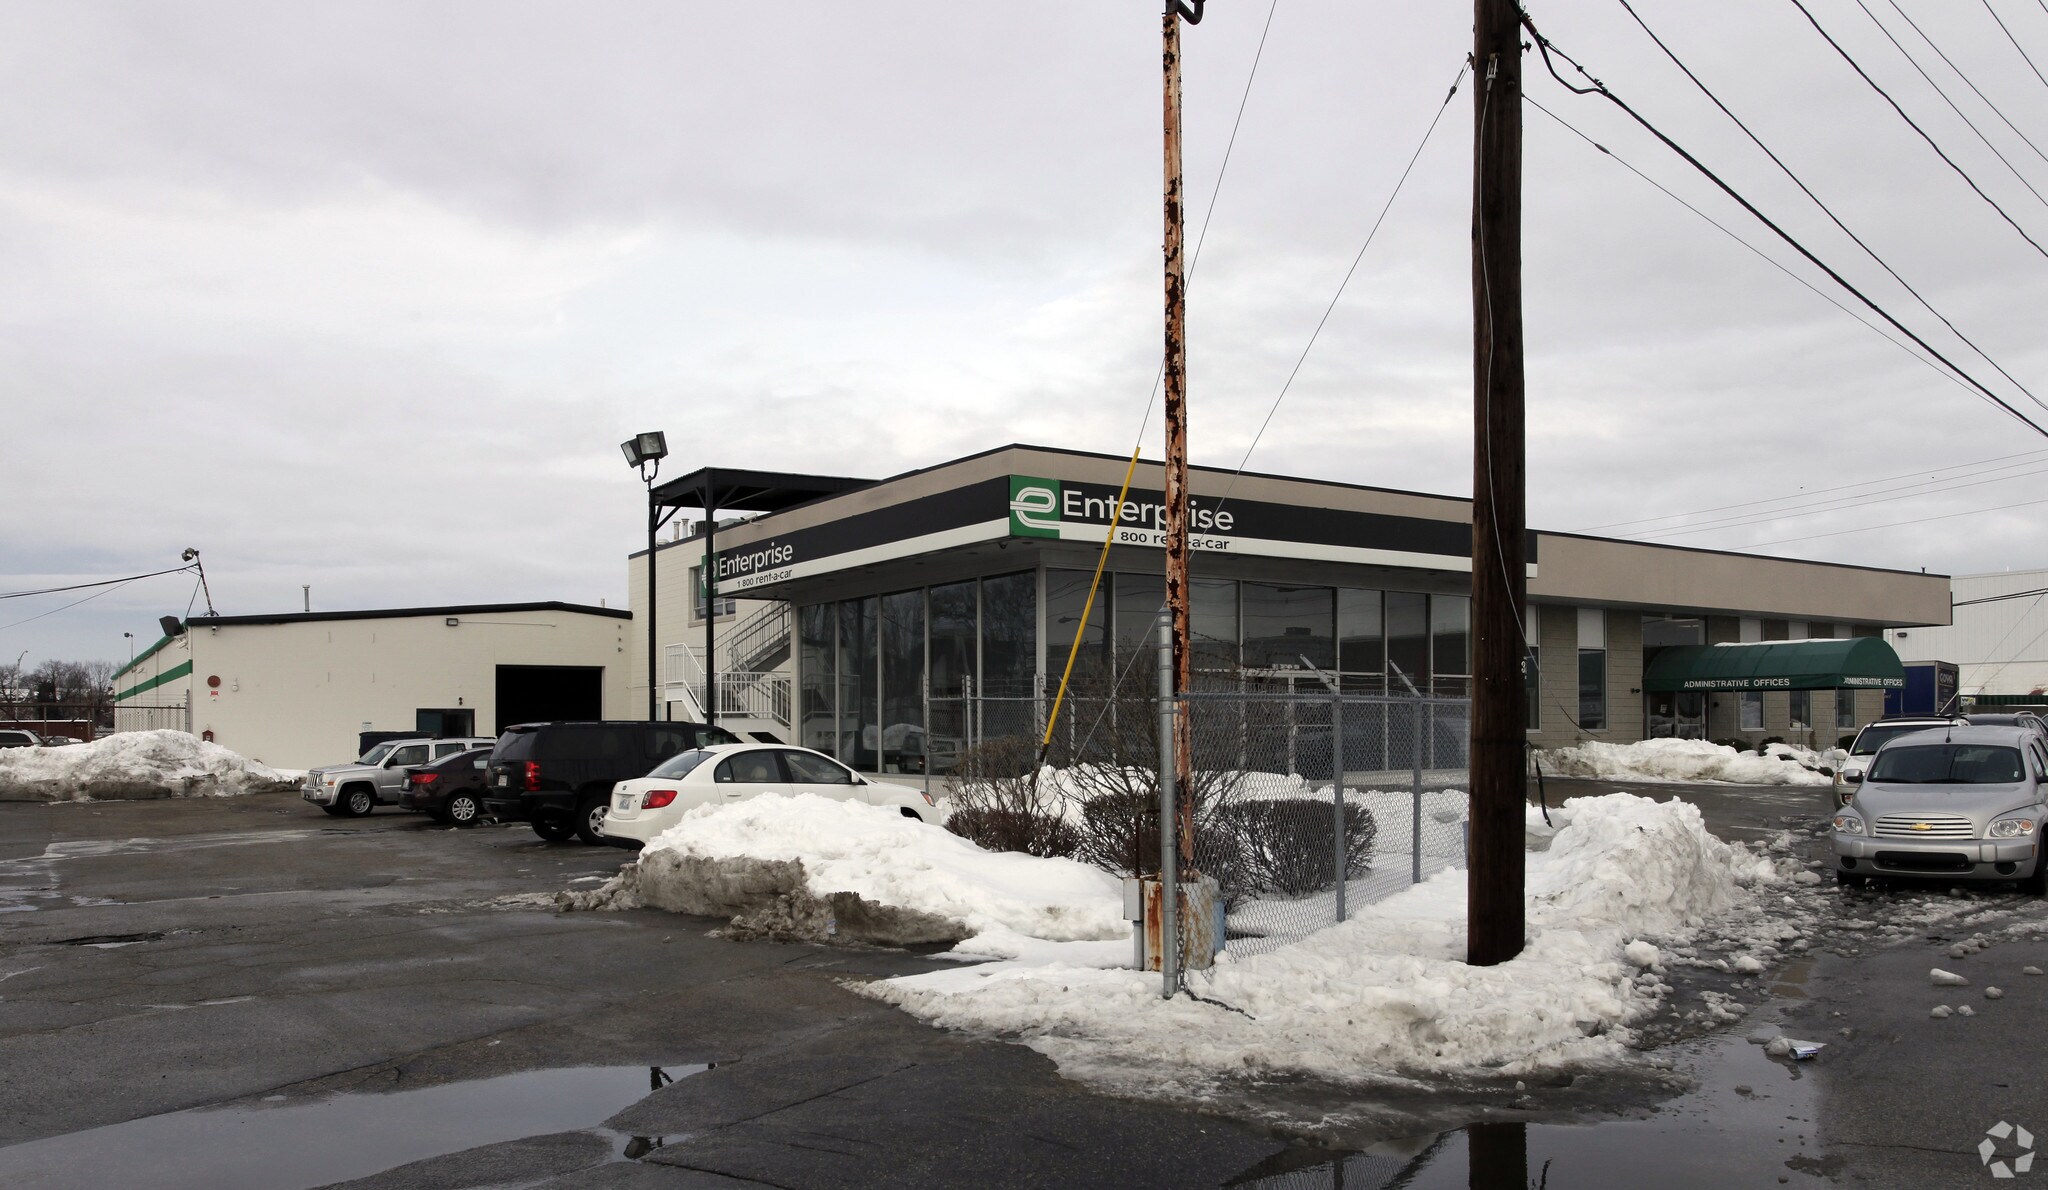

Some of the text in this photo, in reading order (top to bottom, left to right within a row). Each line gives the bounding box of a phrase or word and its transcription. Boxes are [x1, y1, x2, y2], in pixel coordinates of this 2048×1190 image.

[1063, 489, 1234, 532] Enterpise
[1120, 531, 1148, 543] 800
[1153, 534, 1230, 550] re-a-car
[719, 541, 793, 577] Enterprise
[742, 577, 754, 587] 800
[755, 569, 793, 585] rent-a-car
[1683, 678, 1791, 689] ADMINISTRATIVE OFFICES
[1843, 677, 1903, 687] ADMINISTRATIVE OFFICES
